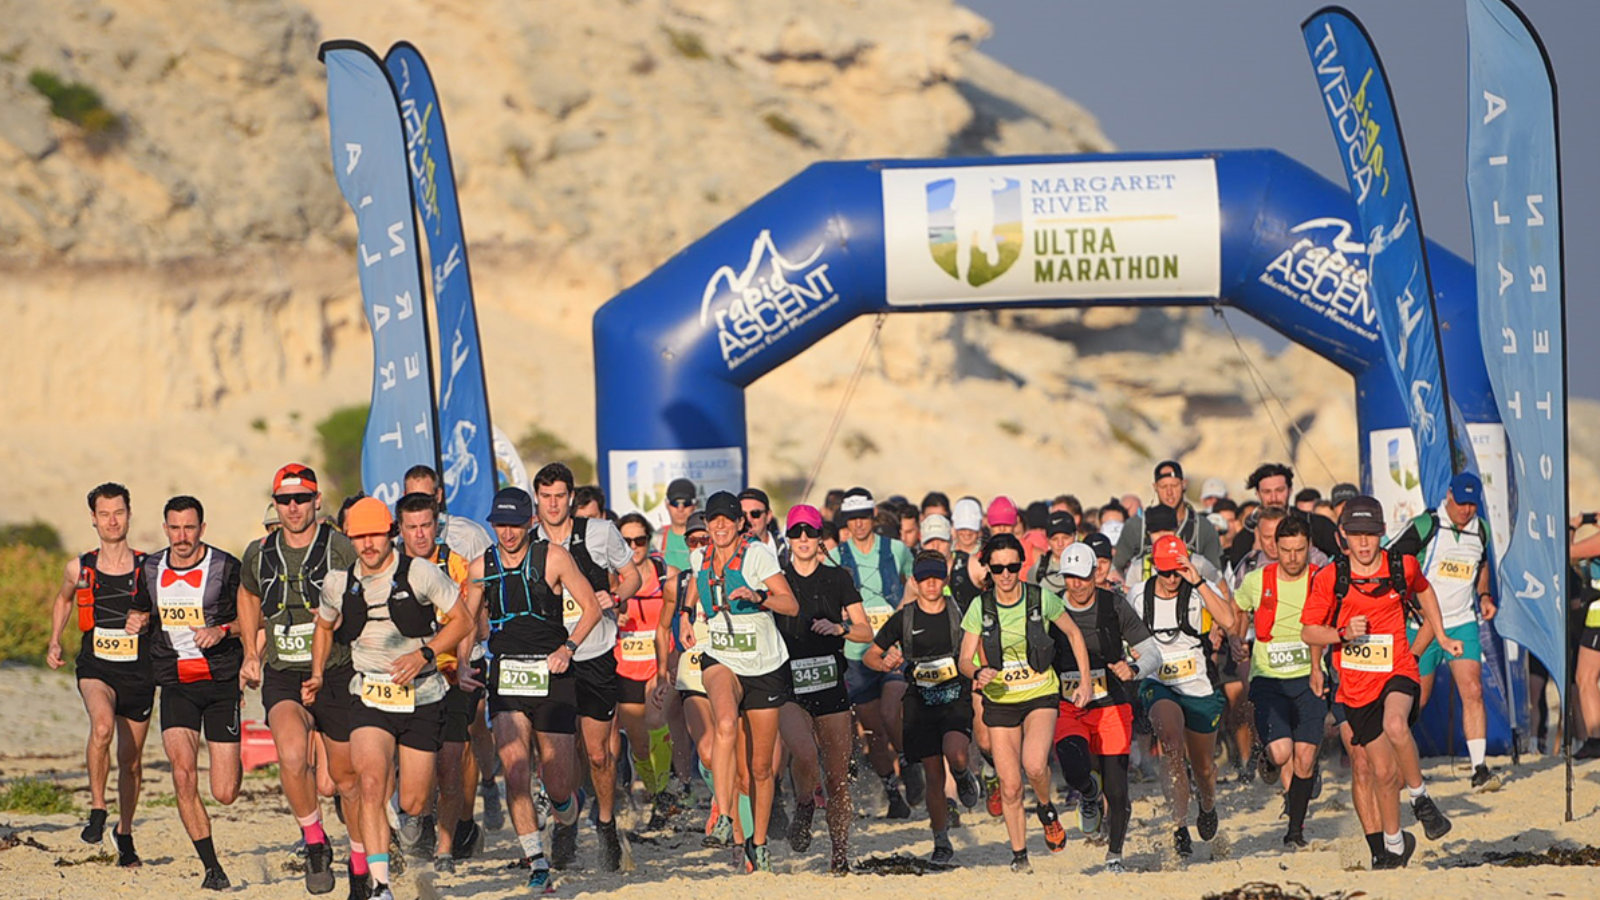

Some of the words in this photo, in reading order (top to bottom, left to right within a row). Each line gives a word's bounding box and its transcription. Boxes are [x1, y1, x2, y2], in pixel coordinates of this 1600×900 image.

[1031, 174, 1176, 194] MARGARET
[1032, 195, 1108, 214] RIVER
[1034, 227, 1116, 256] ULTRA
[1034, 254, 1178, 283] MARATHON
[1265, 247, 1381, 331] ASCEN
[718, 263, 834, 361] ASCENT
